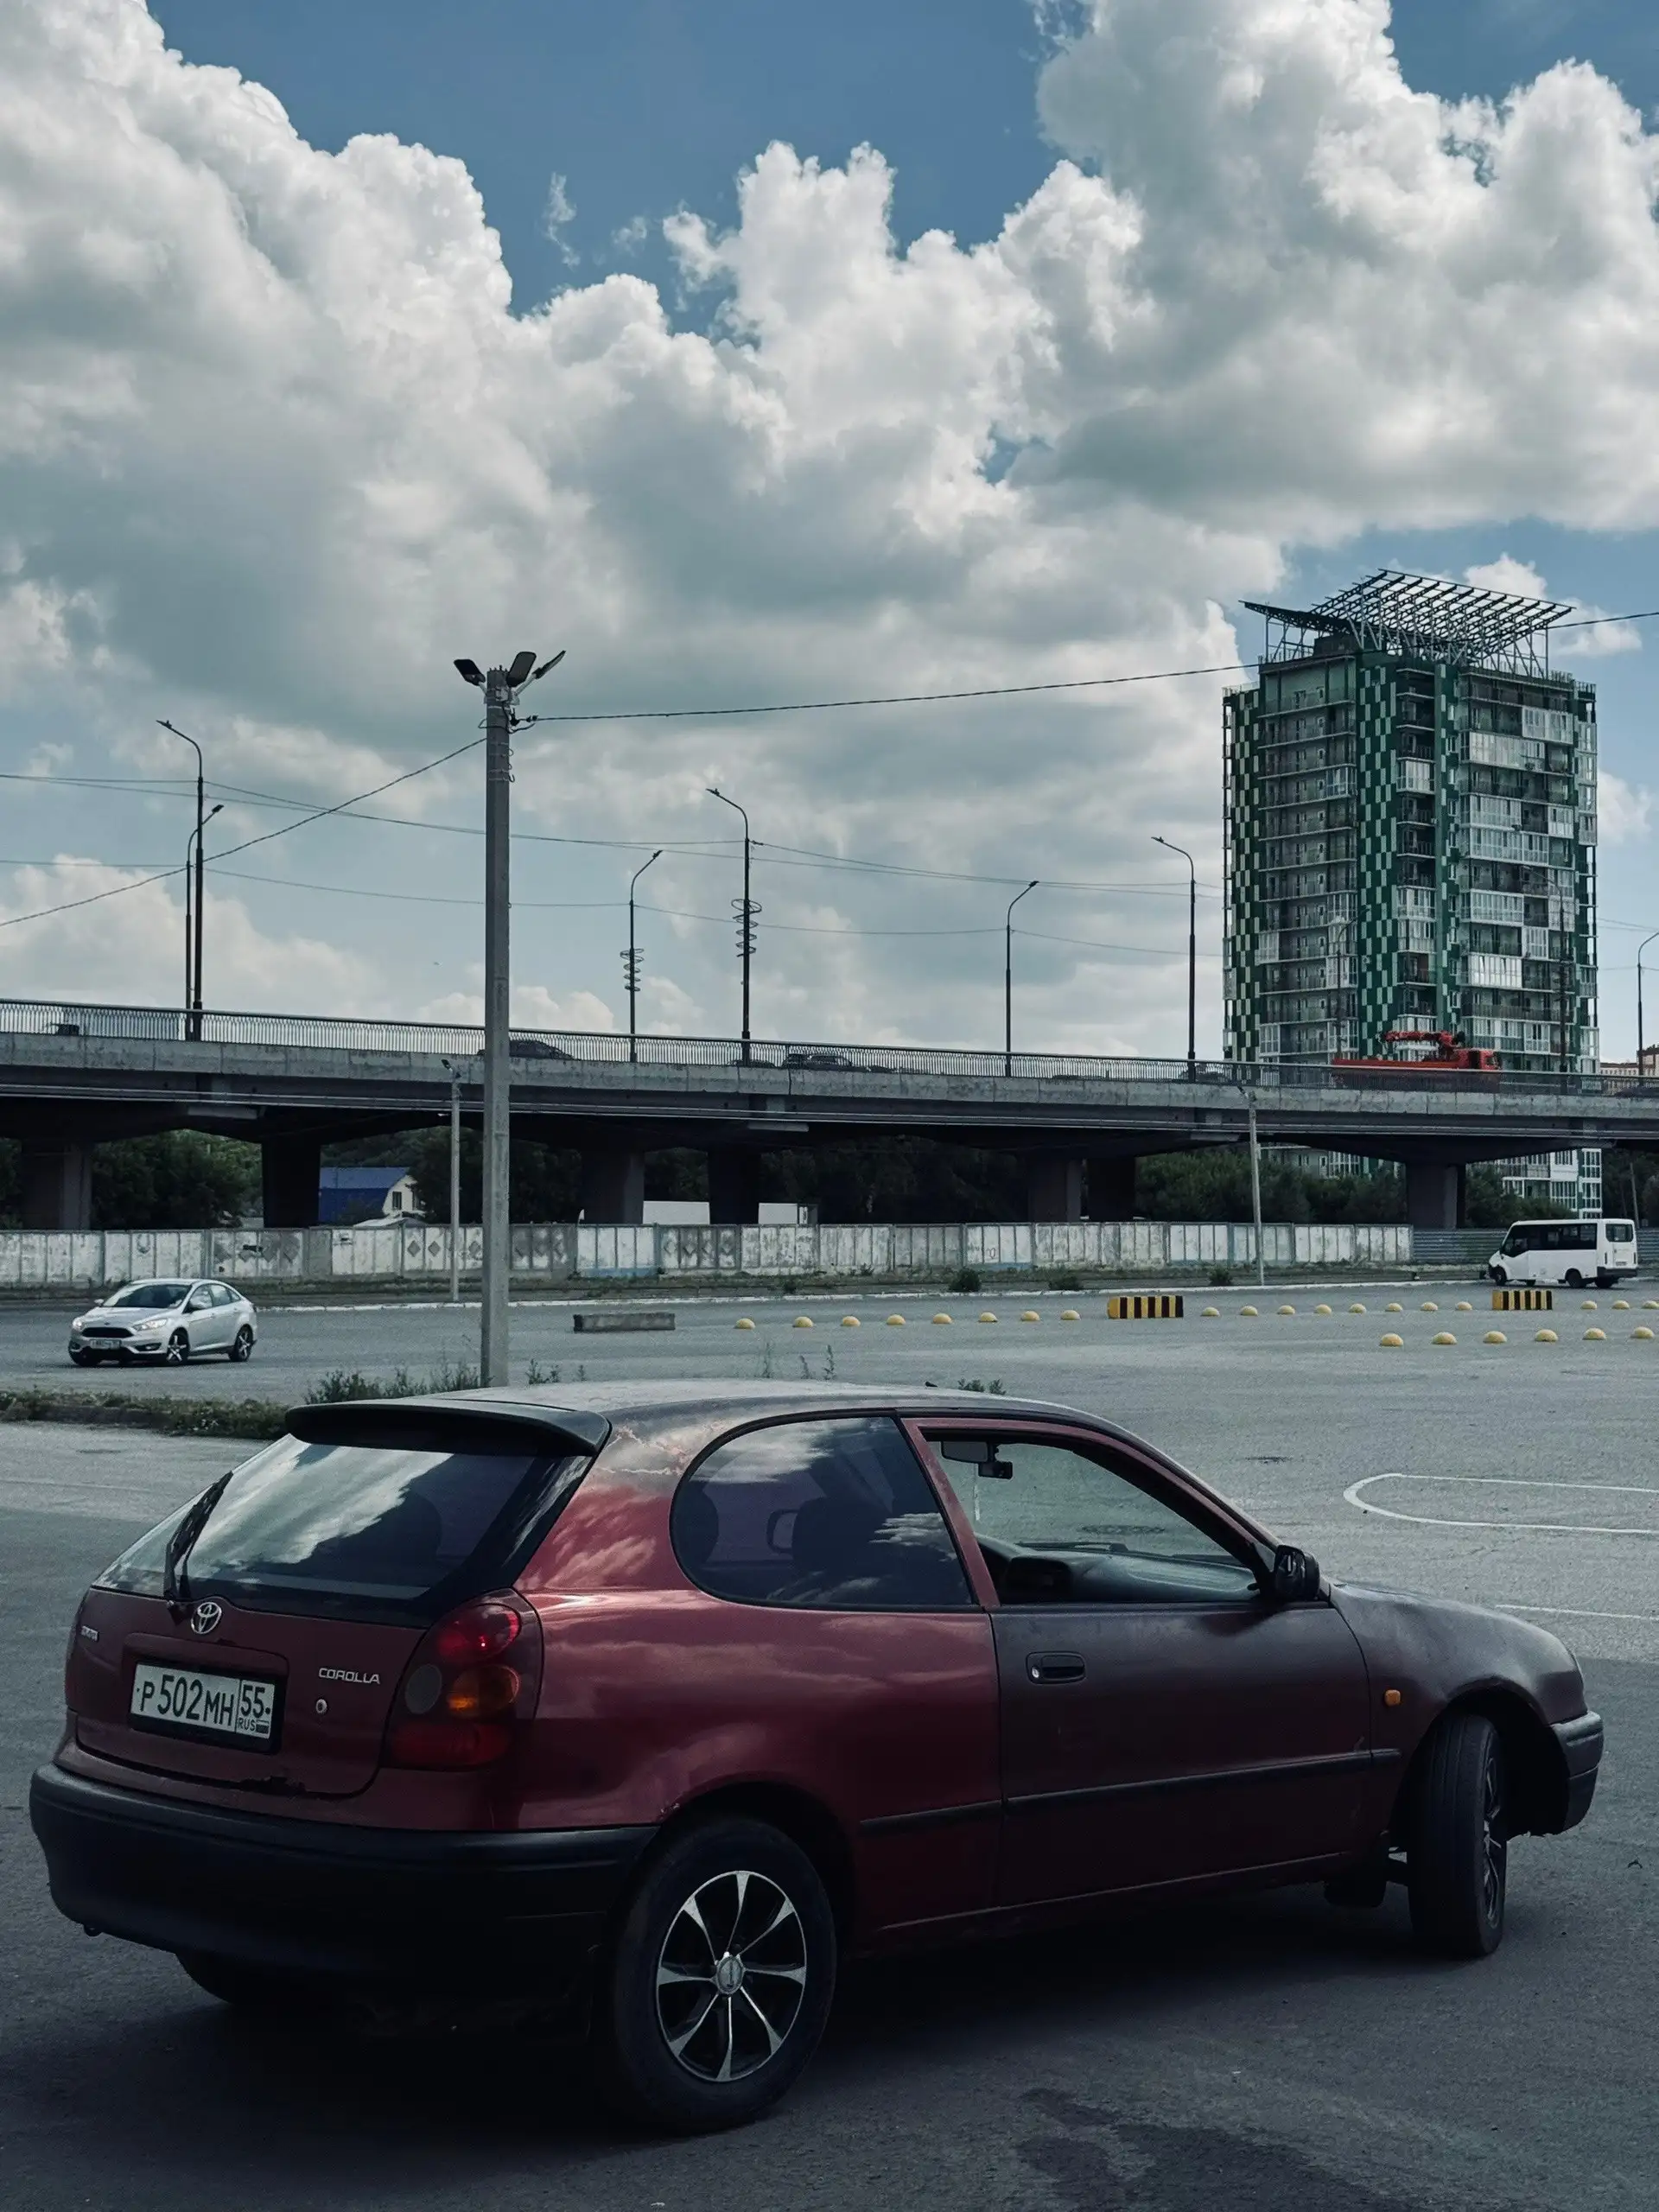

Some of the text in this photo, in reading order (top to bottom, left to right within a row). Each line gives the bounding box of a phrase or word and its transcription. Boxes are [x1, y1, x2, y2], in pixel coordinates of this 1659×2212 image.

[318, 1668, 381, 1684] COROLLA
[240, 1684, 265, 1719] 55
[237, 1717, 256, 1732] RUS
